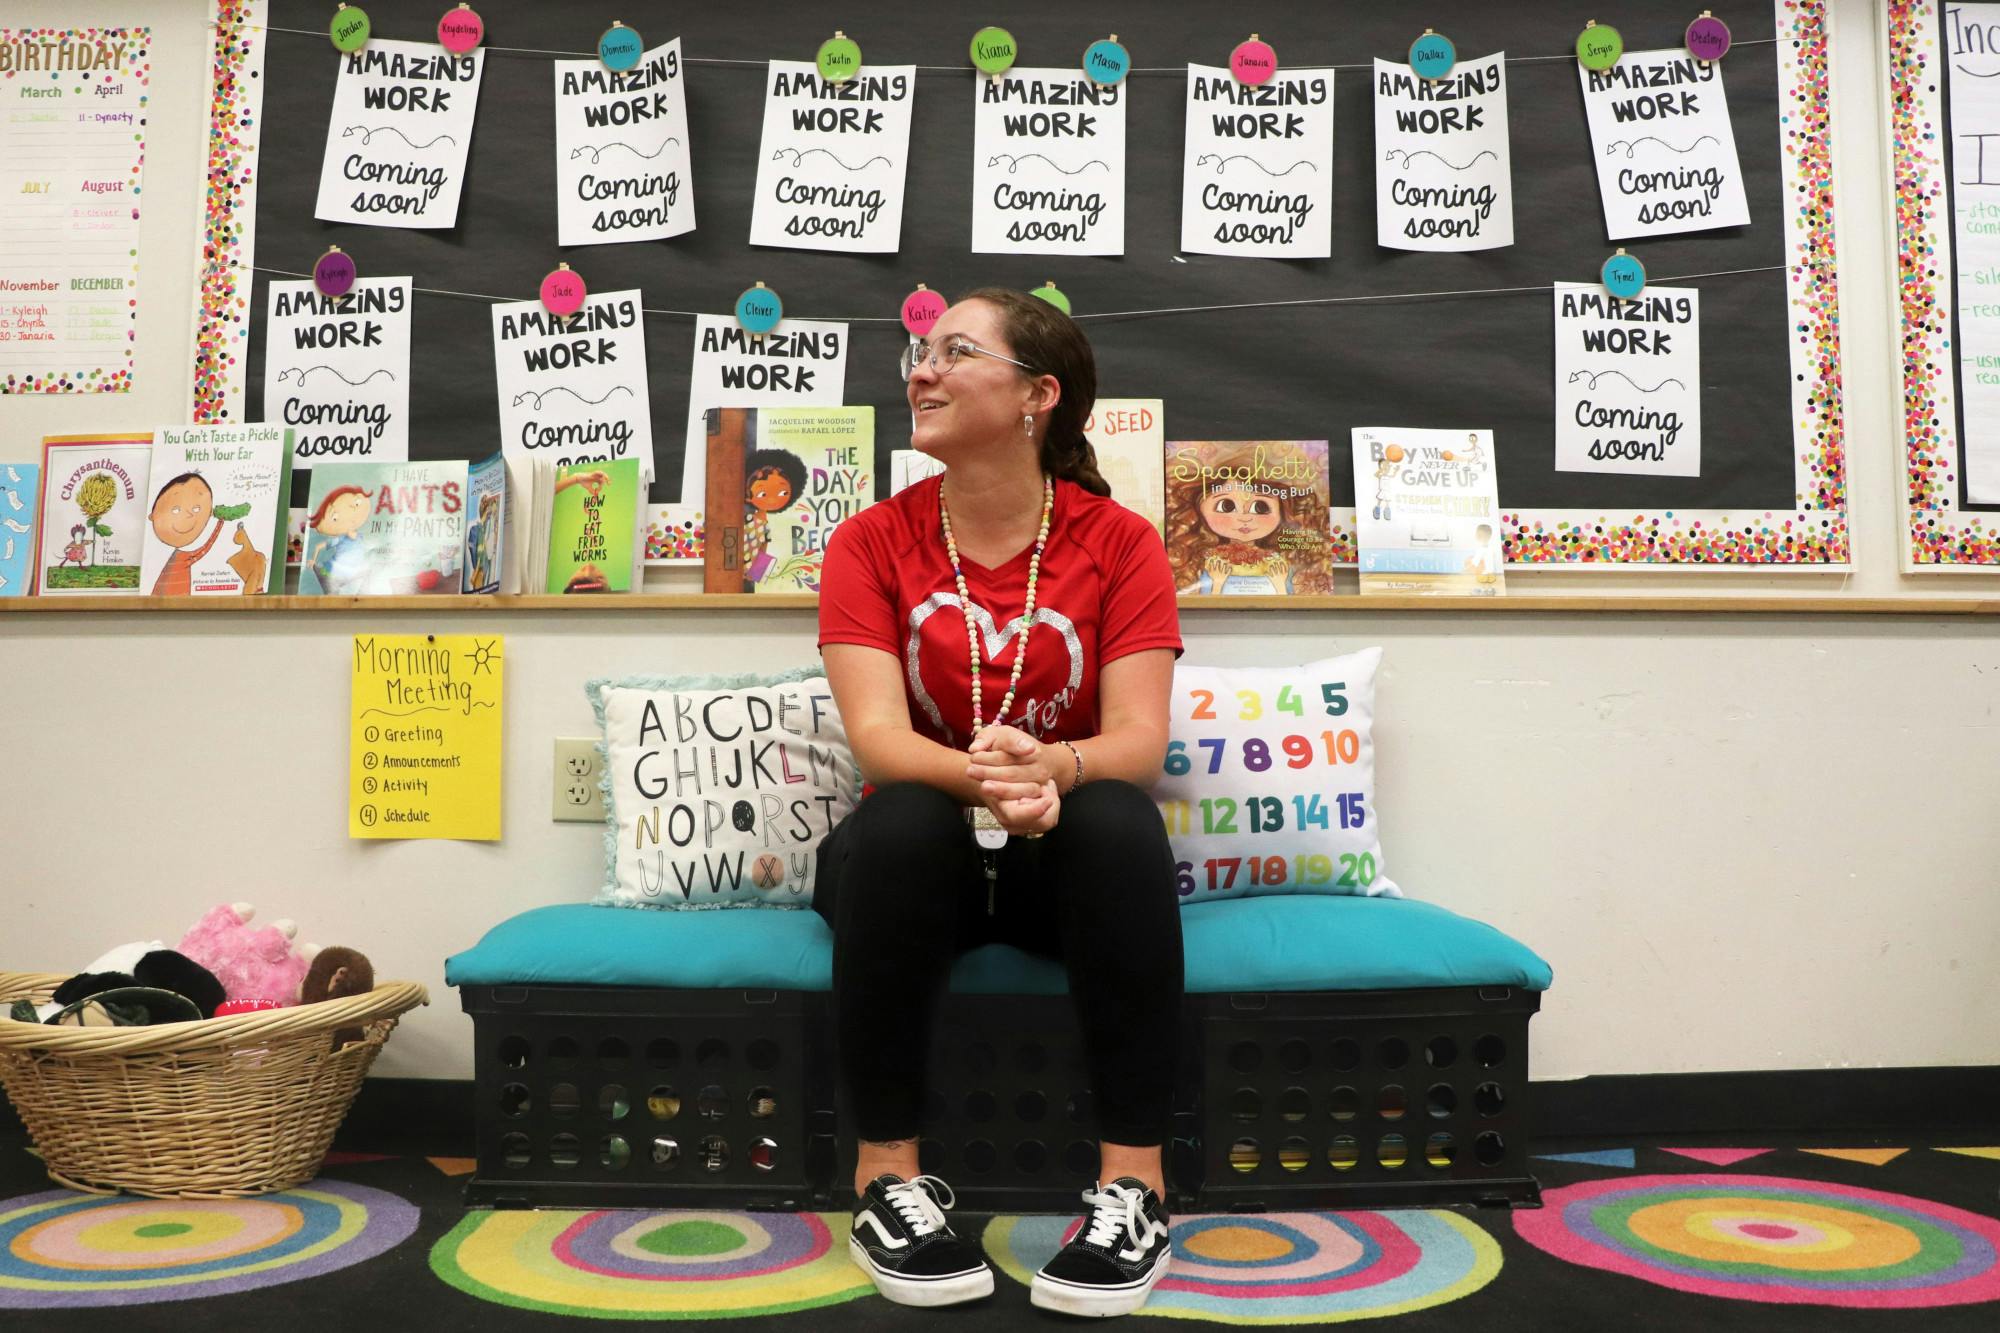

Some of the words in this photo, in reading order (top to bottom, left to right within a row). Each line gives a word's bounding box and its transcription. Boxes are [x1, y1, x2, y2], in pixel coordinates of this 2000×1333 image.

[336, 20, 364, 42] Jordan
[0, 43, 126, 71] BIRTHDAY
[825, 53, 852, 65] Justin
[977, 41, 1013, 60] Kiana
[1091, 51, 1121, 72] Mason
[1586, 42, 1613, 57] Sergio
[21, 87, 62, 98] March
[94, 84, 123, 98] April
[364, 86, 451, 113] WORK
[584, 93, 668, 128] WORK
[792, 108, 884, 134] WORK
[1396, 105, 1485, 134] WORK
[1611, 95, 1701, 123] WORK
[1003, 112, 1097, 138] WORK
[1212, 113, 1305, 139] WORK
[81, 180, 125, 194] August
[343, 153, 447, 200] Coming
[578, 170, 680, 205] Coming
[1618, 166, 1724, 199] Coming
[351, 189, 427, 216] soon!
[775, 176, 886, 223] Coming
[993, 183, 1106, 226] Coming
[1202, 183, 1313, 228] Coming
[1391, 178, 1496, 219] Coming
[1637, 195, 1713, 224] soon!
[591, 196, 669, 232] soon!
[784, 212, 866, 239] soon!
[1404, 210, 1480, 238] soon!
[1006, 216, 1087, 242] soon!
[1213, 217, 1294, 244] soon!
[0, 279, 60, 291] November
[70, 278, 124, 290] DECEMBER
[551, 285, 574, 299] Jade
[908, 305, 939, 322] Katie
[294, 321, 383, 350] WORK
[1582, 328, 1672, 355] WORK
[524, 338, 618, 373] WORK
[721, 364, 815, 393] WORK
[283, 398, 391, 437] Coming
[769, 418, 815, 426] JACQUELINE
[1104, 408, 1153, 435] SEED
[1575, 400, 1683, 446] Coming
[163, 430, 181, 444] You
[183, 430, 208, 444] Can't
[210, 429, 237, 443] Taste
[239, 433, 245, 442] a
[247, 428, 279, 441] Pickle
[295, 427, 373, 457] soon!
[521, 420, 633, 455] Coming
[1588, 434, 1664, 461] soon!
[185, 448, 210, 463] With
[213, 447, 235, 461] Your
[237, 446, 254, 460] Ear
[825, 446, 859, 467] THE
[1419, 461, 1460, 470] NEVER
[61, 458, 135, 501] Chrysanthemum
[393, 470, 398, 481] I
[402, 469, 430, 482] HAVE
[813, 467, 859, 497] DAY
[1174, 445, 1317, 500] Spaghetti
[1401, 469, 1452, 487] GAVE
[1456, 468, 1479, 488] UP
[374, 481, 462, 515] ANTS
[584, 494, 606, 508] HOW
[1211, 483, 1222, 494] in
[1225, 484, 1233, 493] a
[1235, 482, 1258, 494] Hot
[1262, 485, 1288, 500] Dog
[1290, 485, 1314, 498] Bun
[588, 508, 599, 522] TO
[806, 498, 861, 528] YOU
[370, 521, 381, 533] IN
[403, 517, 461, 538] PANTS!
[584, 522, 602, 535] EAT
[573, 549, 607, 562] WORMS
[578, 535, 605, 549] FRIED
[355, 637, 452, 687] Morning
[386, 678, 472, 716] Meeting
[1190, 689, 1217, 720] 2
[1236, 689, 1263, 721] 3
[1276, 684, 1304, 716] 4
[1321, 682, 1349, 717] 5
[385, 725, 444, 746] Greeting
[383, 755, 461, 768] Announcements
[1163, 741, 1191, 776] 6
[1198, 738, 1226, 774] 7
[1242, 737, 1273, 772] 8
[1281, 734, 1313, 769] 9
[1320, 729, 1360, 765] 10
[383, 779, 428, 795] Activity
[384, 808, 431, 823] Schedule
[1162, 801, 1191, 836] 11
[1198, 797, 1238, 834] 12
[1245, 796, 1285, 834] 13
[1292, 794, 1329, 831] 14
[1335, 792, 1366, 829] 15
[1203, 857, 1242, 891] 17
[1246, 855, 1287, 886] 18
[1294, 854, 1333, 886] 19
[1336, 851, 1376, 887] 20
